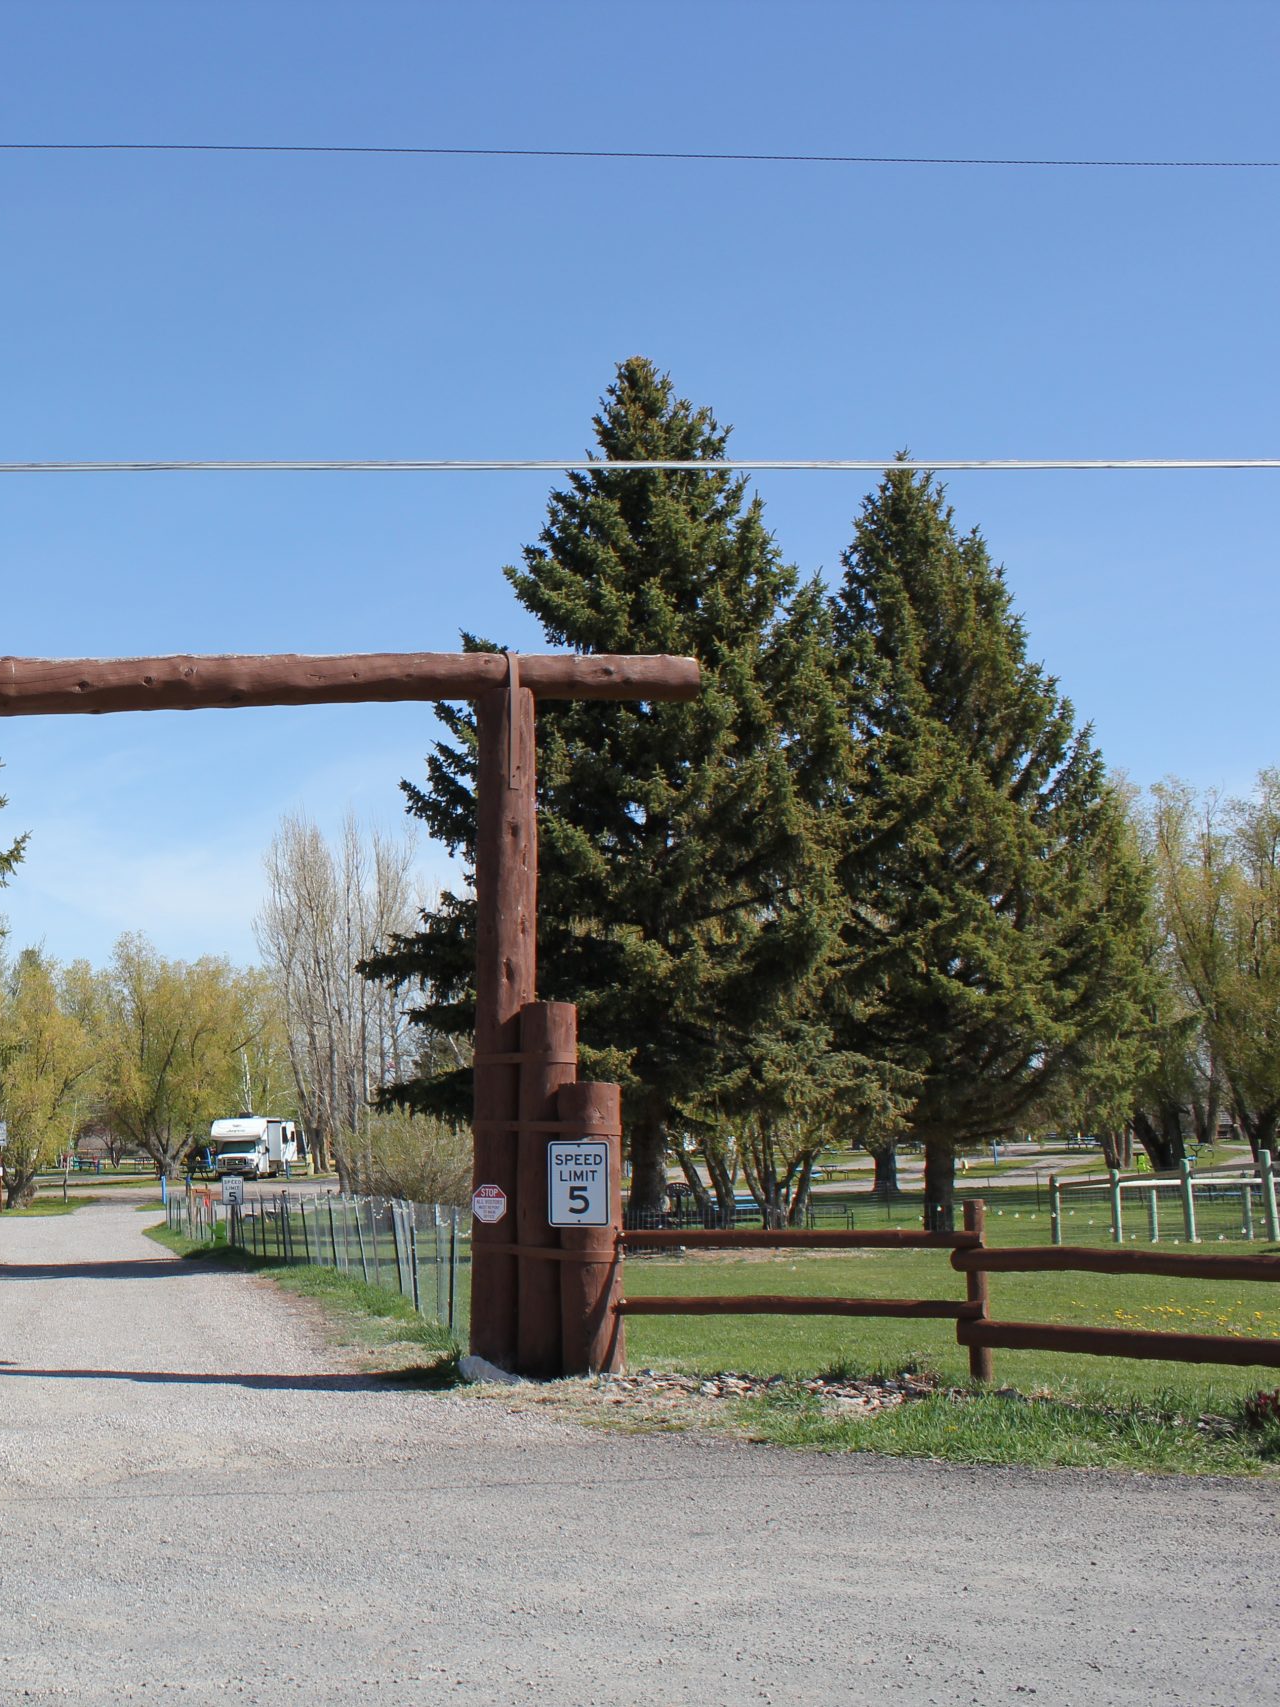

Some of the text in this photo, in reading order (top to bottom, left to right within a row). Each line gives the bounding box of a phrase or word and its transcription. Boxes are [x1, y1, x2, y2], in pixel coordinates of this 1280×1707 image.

[555, 1154, 603, 1166] SPEED
[559, 1170, 598, 1182] LIMIT
[228, 1191, 237, 1202] 5
[480, 1188, 498, 1197] STOP
[568, 1185, 590, 1214] 5
